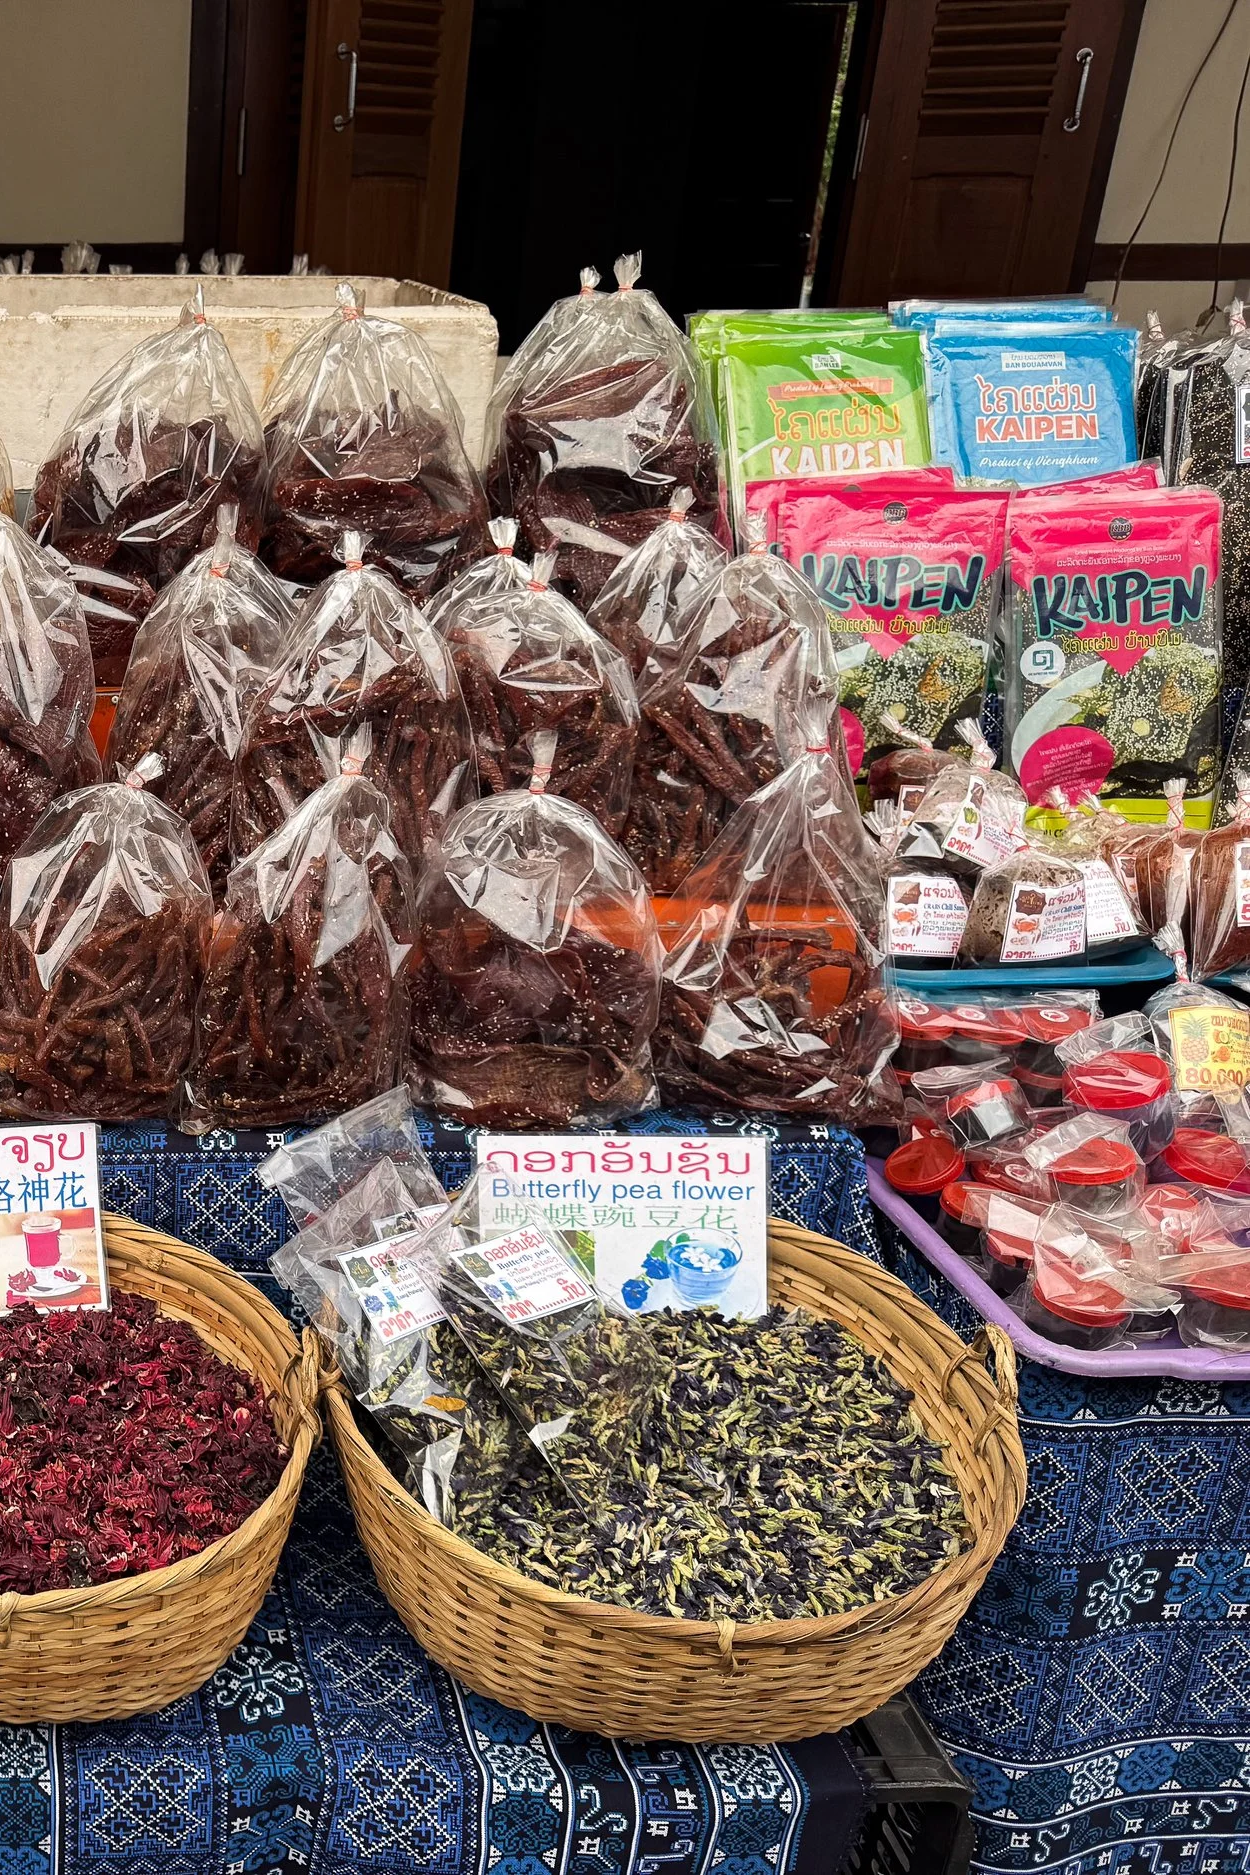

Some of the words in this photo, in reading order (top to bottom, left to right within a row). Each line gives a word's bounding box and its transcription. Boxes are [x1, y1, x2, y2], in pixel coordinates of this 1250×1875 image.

[977, 414, 1098, 443] KAIPEN
[771, 438, 906, 475] KAIPEN
[979, 457, 1022, 468] Product
[1024, 457, 1034, 469] of
[1035, 455, 1100, 467] Viengkham
[801, 553, 986, 614] KAIPEN
[1032, 565, 1207, 639] KAIPEN
[492, 1178, 601, 1201] Butterfly
[612, 1183, 662, 1203] pea
[674, 1179, 755, 1200] flower
[497, 1253, 534, 1270] Butterfly
[535, 1248, 550, 1258] pea
